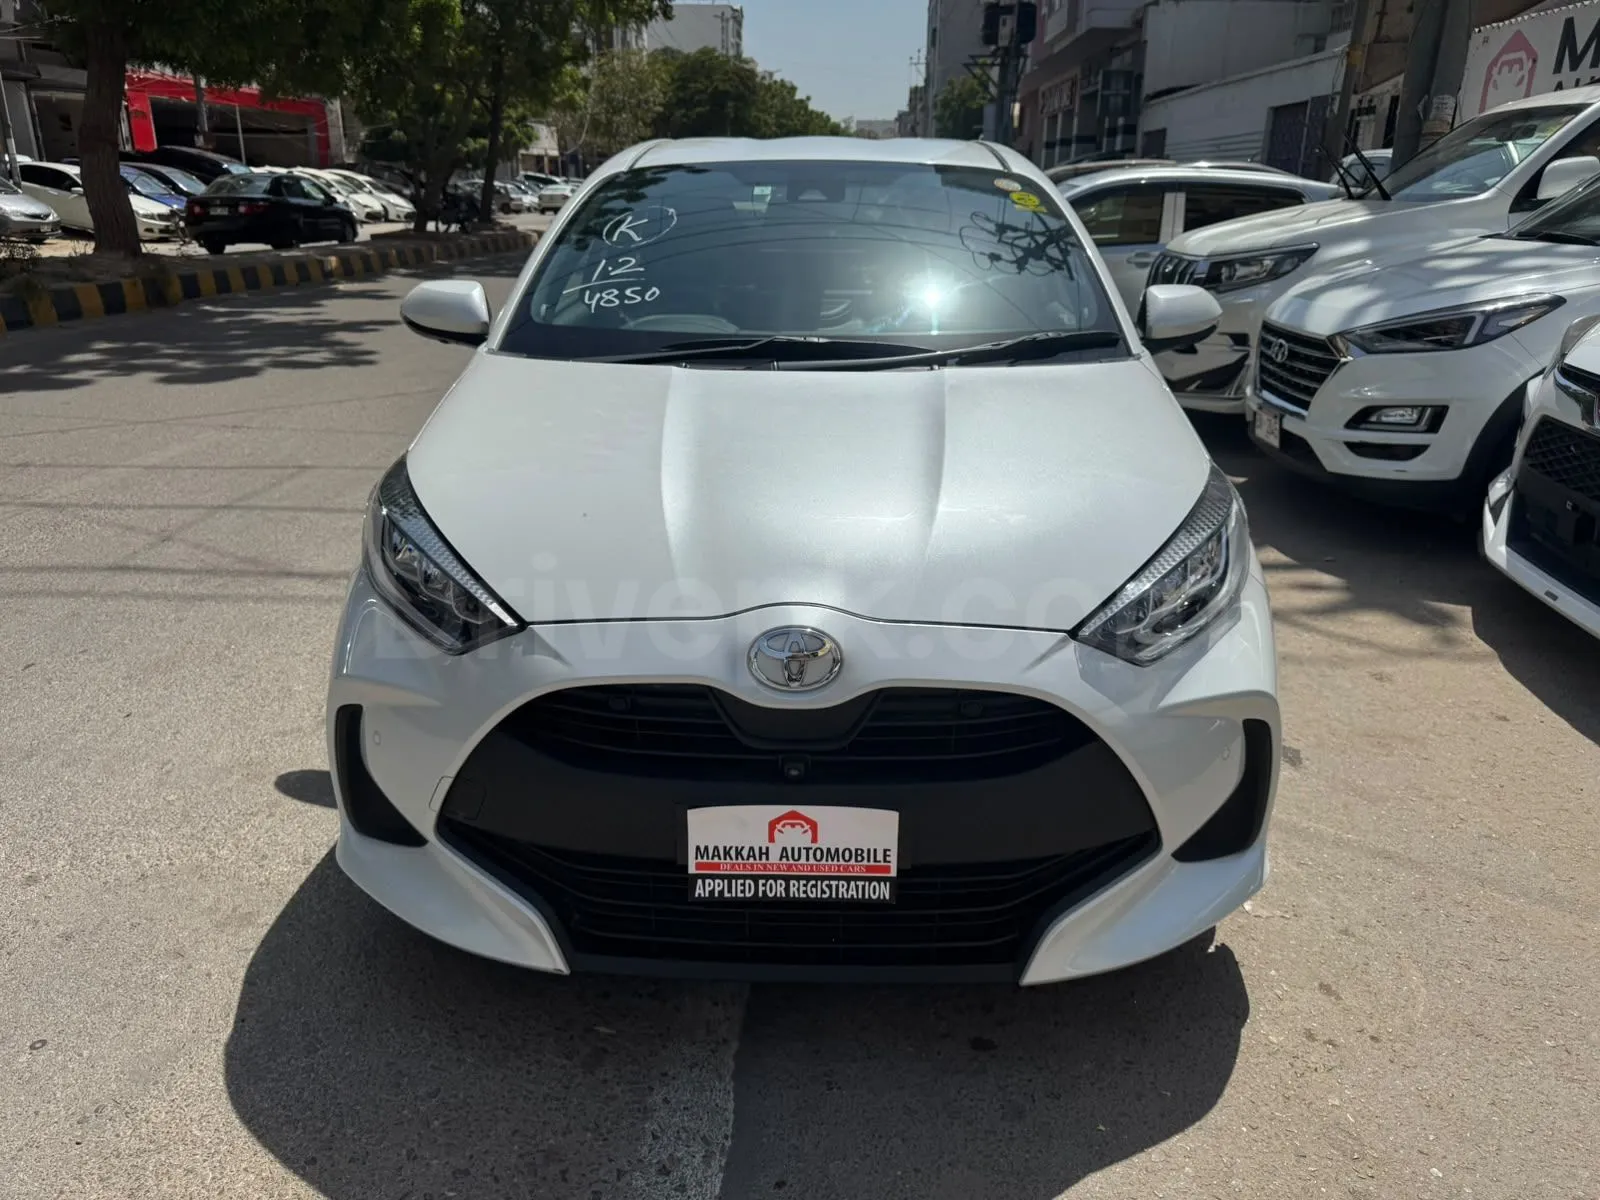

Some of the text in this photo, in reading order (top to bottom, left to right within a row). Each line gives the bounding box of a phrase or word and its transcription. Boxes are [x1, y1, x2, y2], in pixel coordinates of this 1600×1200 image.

[612, 215, 648, 241] K
[591, 256, 645, 283] 1.2
[584, 286, 660, 314] 4850
[695, 844, 892, 864] MAKKAH AUTOMOBILE
[720, 862, 867, 874] DEALS IN NEW AND USED CARS
[695, 878, 890, 900] APPLIED FOR REGISTRATION
